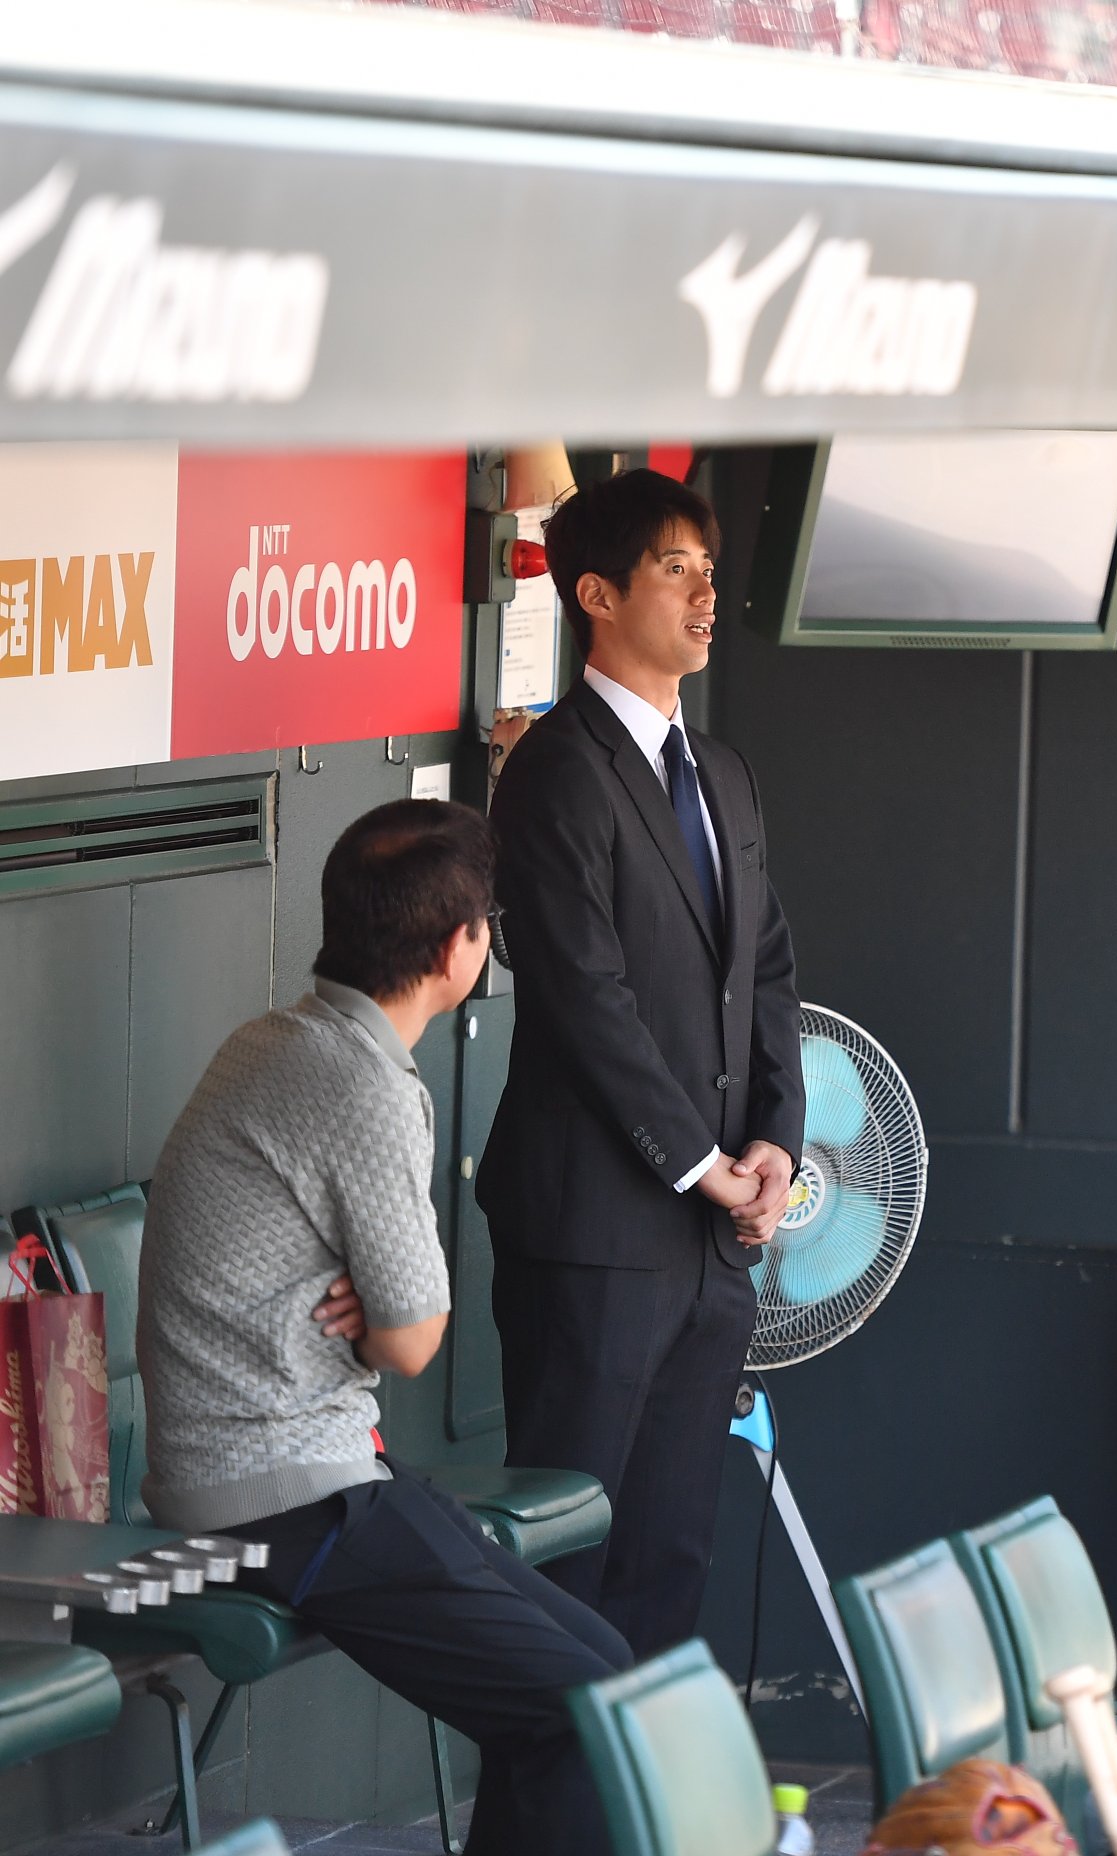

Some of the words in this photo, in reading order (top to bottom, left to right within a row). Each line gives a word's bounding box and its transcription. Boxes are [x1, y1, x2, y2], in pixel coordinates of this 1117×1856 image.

[226, 525, 417, 662] docomo
[262, 524, 291, 555] NTT
[40, 552, 155, 676] MAX
